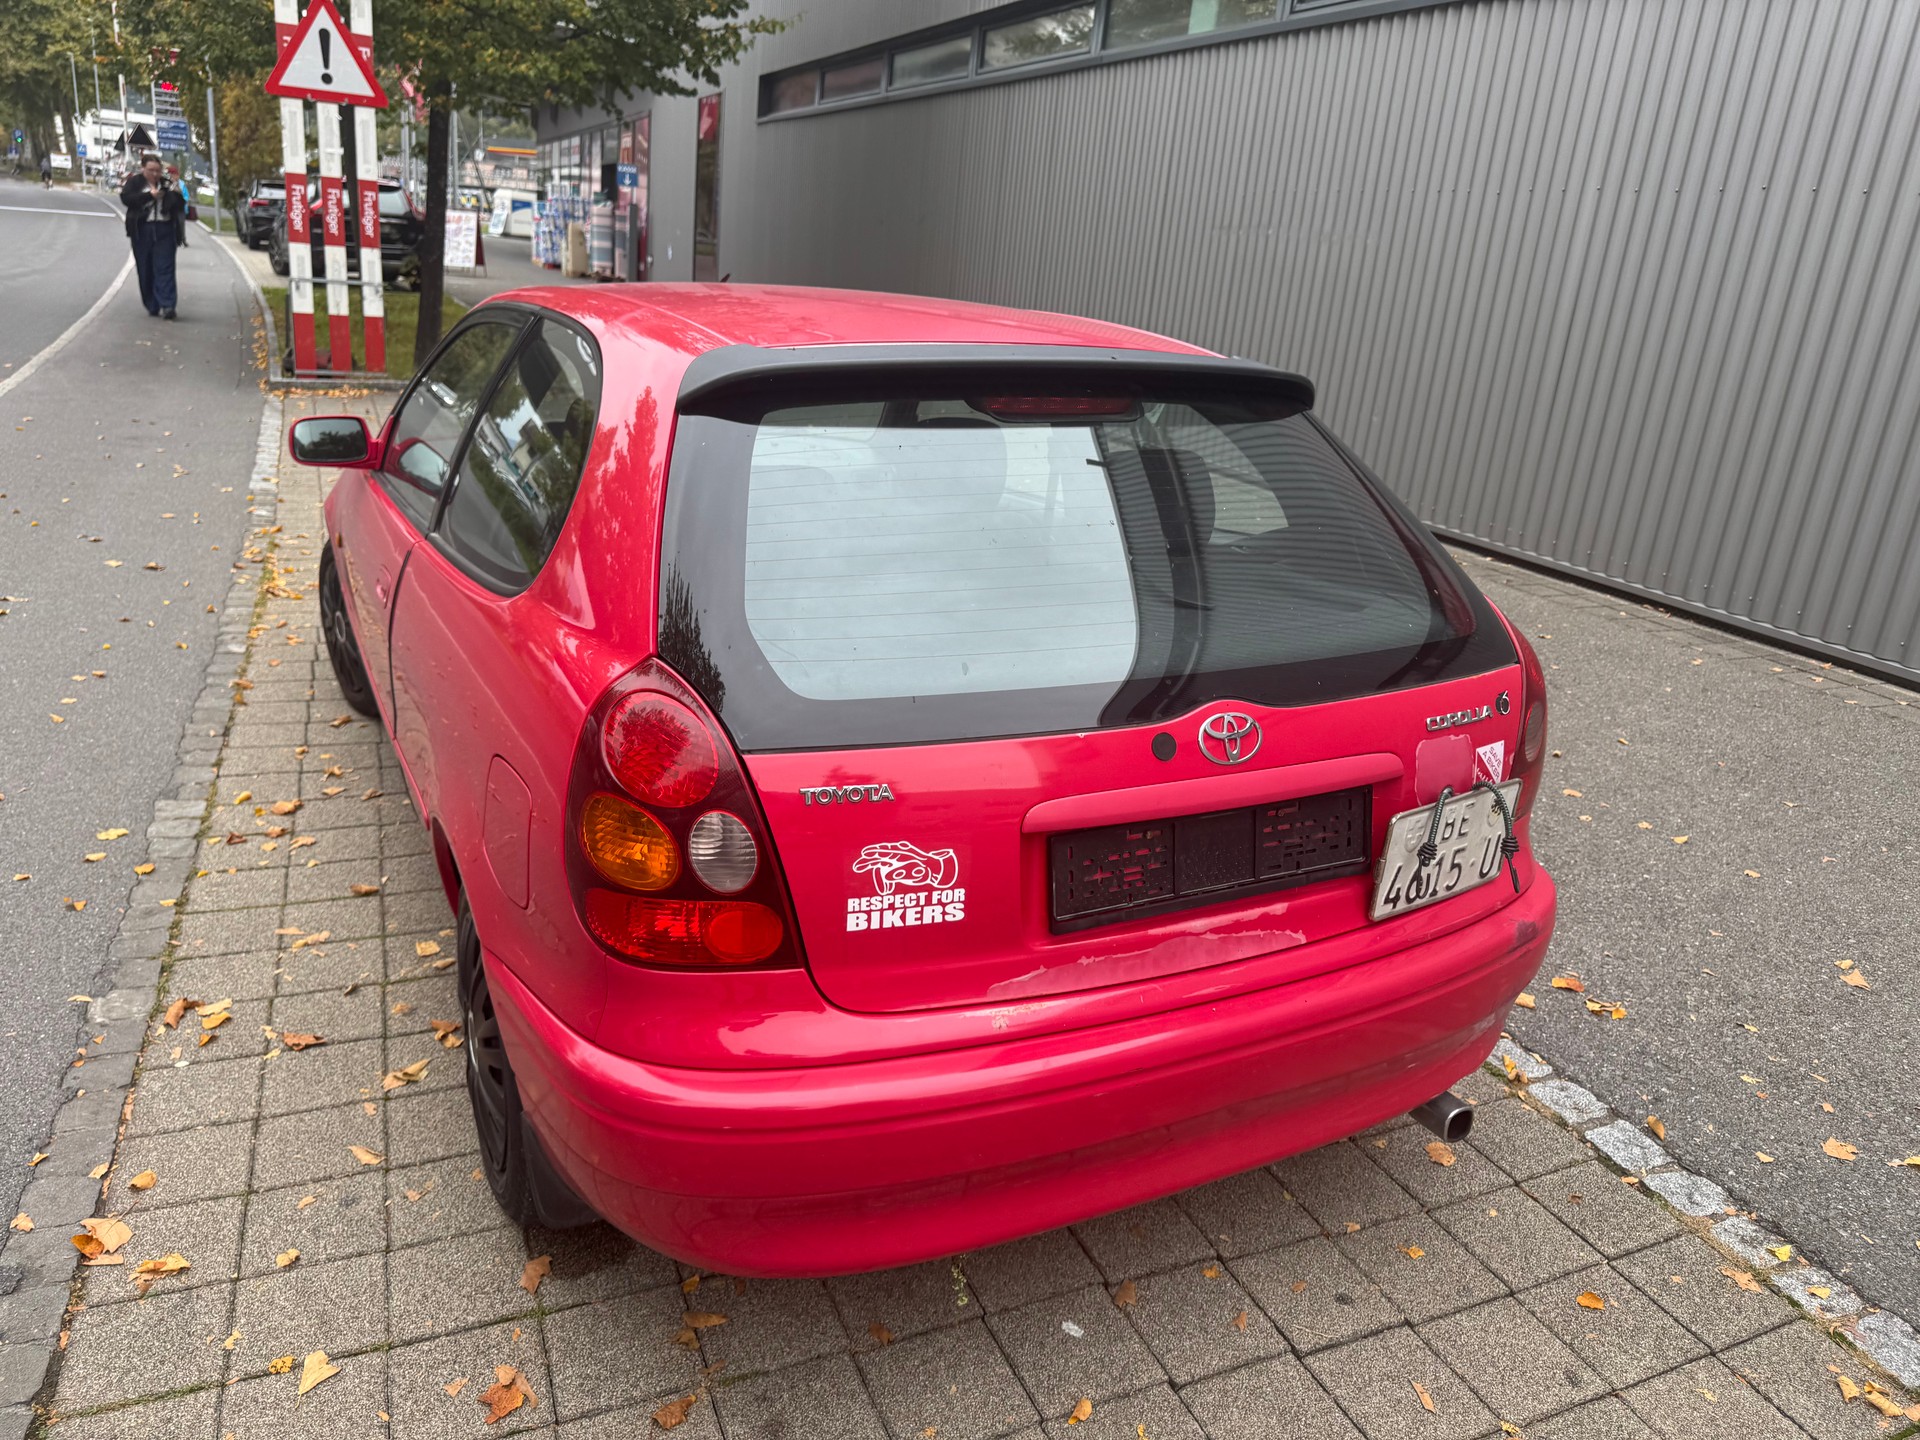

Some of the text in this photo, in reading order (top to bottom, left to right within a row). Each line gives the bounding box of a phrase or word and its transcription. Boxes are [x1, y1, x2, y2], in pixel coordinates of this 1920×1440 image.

[289, 184, 306, 233] Frutiger
[325, 187, 341, 237] Frutiger
[361, 190, 377, 239] Frutiger
[1426, 705, 1493, 731] COROLLA
[1482, 750, 1488, 759] A
[1486, 756, 1500, 779] BIKER
[1488, 746, 1502, 768] SAVE
[799, 784, 895, 805] TOYOTA
[1441, 800, 1476, 841] BE
[847, 888, 965, 912] RESPECT FOR
[846, 902, 965, 932] BIKERS
